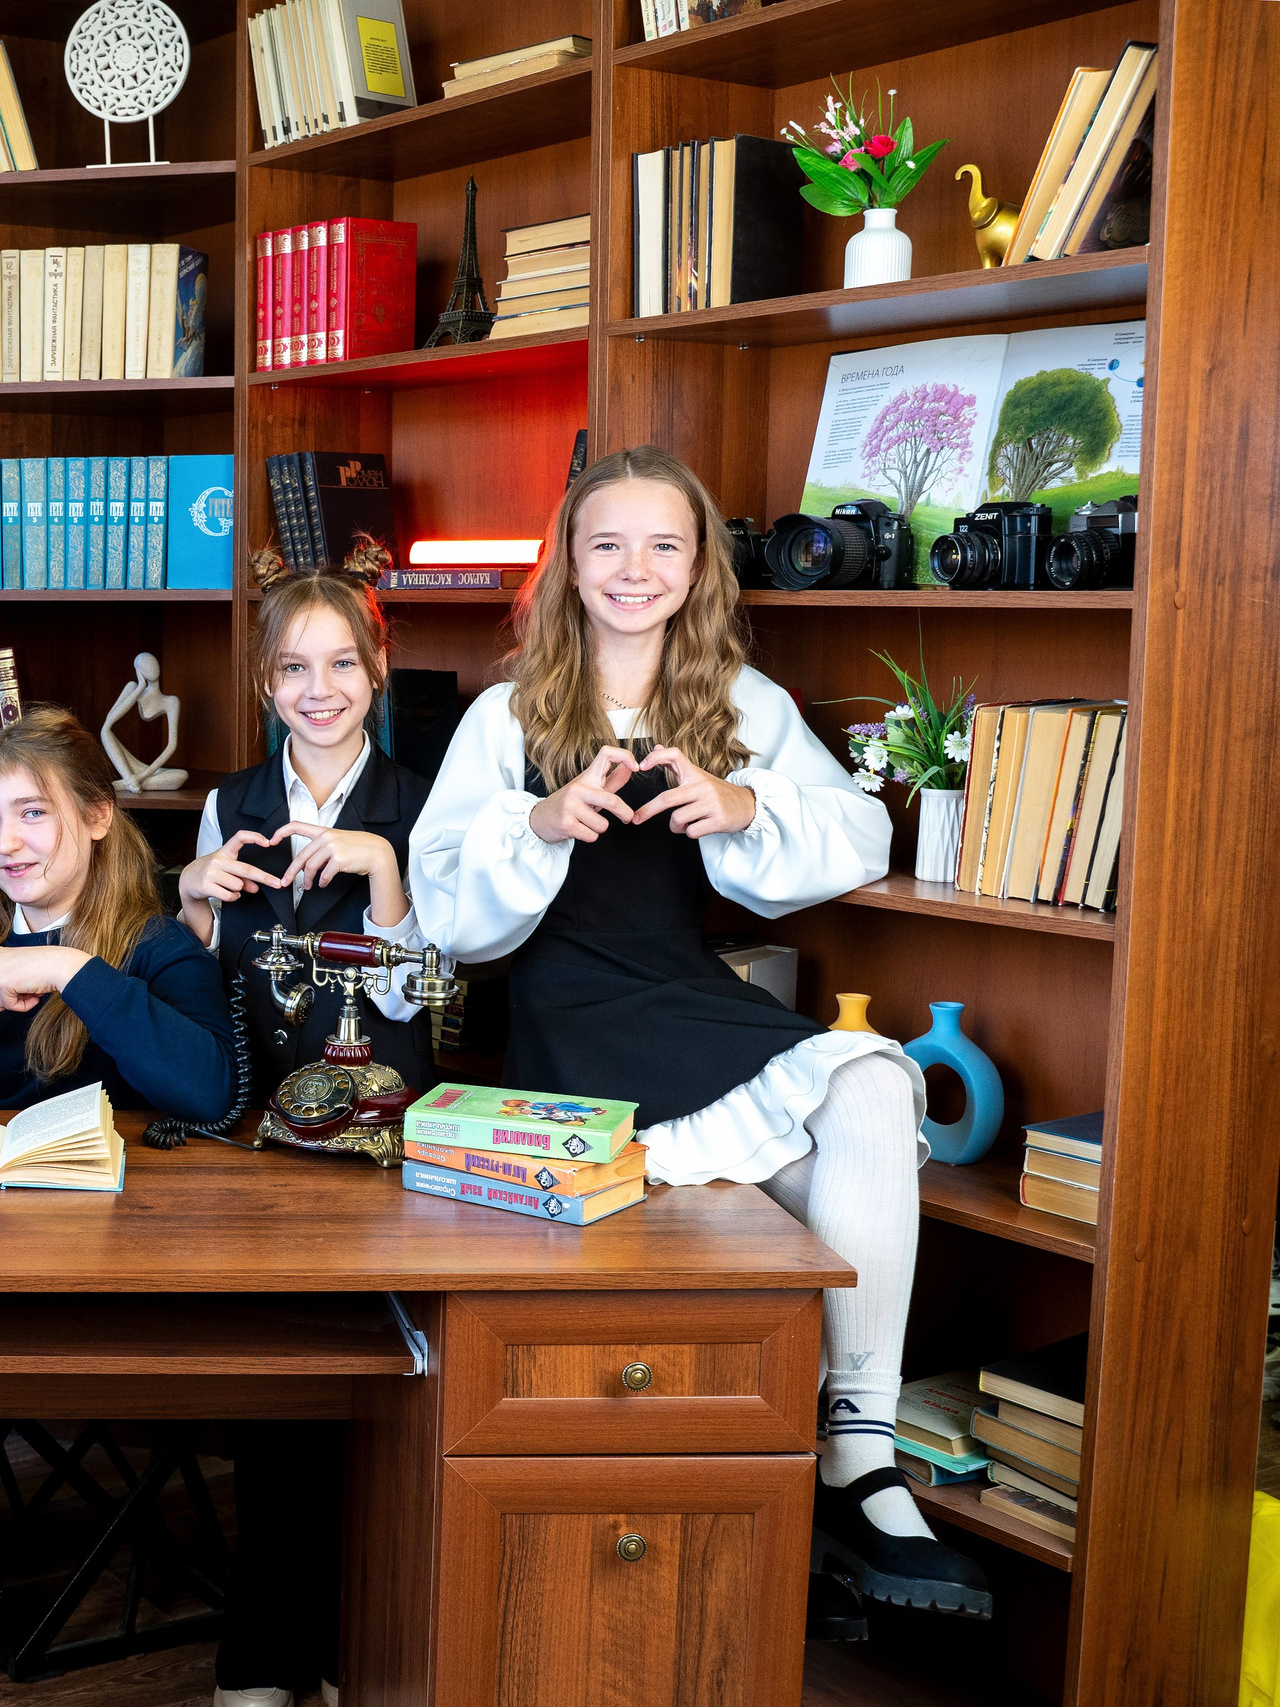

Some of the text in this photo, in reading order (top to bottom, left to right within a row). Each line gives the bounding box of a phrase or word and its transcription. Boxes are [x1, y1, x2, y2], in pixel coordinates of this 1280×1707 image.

[840, 365, 905, 384] ВРЕМЕНА ГОДА
[3, 502, 19, 517] ГЕТЕ
[27, 502, 43, 518] ГЕТЕ
[49, 501, 64, 517] ГЕТЕ
[68, 502, 84, 518] ГЕТЕ
[89, 501, 105, 516] ГЕТЕ
[109, 501, 125, 517] ГЕТЕ
[130, 502, 145, 517] ГЕТЕ
[149, 501, 165, 517] ГЕТЕ
[974, 512, 999, 521] ZENIT
[401, 571, 491, 586] КАРЛОС КАСТАНЕДА
[415, 1119, 461, 1132] школьника
[415, 1129, 460, 1141] Справочник
[492, 1128, 552, 1151] Биология
[415, 1141, 456, 1156] школьника
[416, 1149, 447, 1163] Словарь
[464, 1152, 528, 1183] Англо-русский
[415, 1171, 457, 1186] школьника
[415, 1181, 457, 1197] Справочник
[459, 1181, 540, 1211] Английский язык
